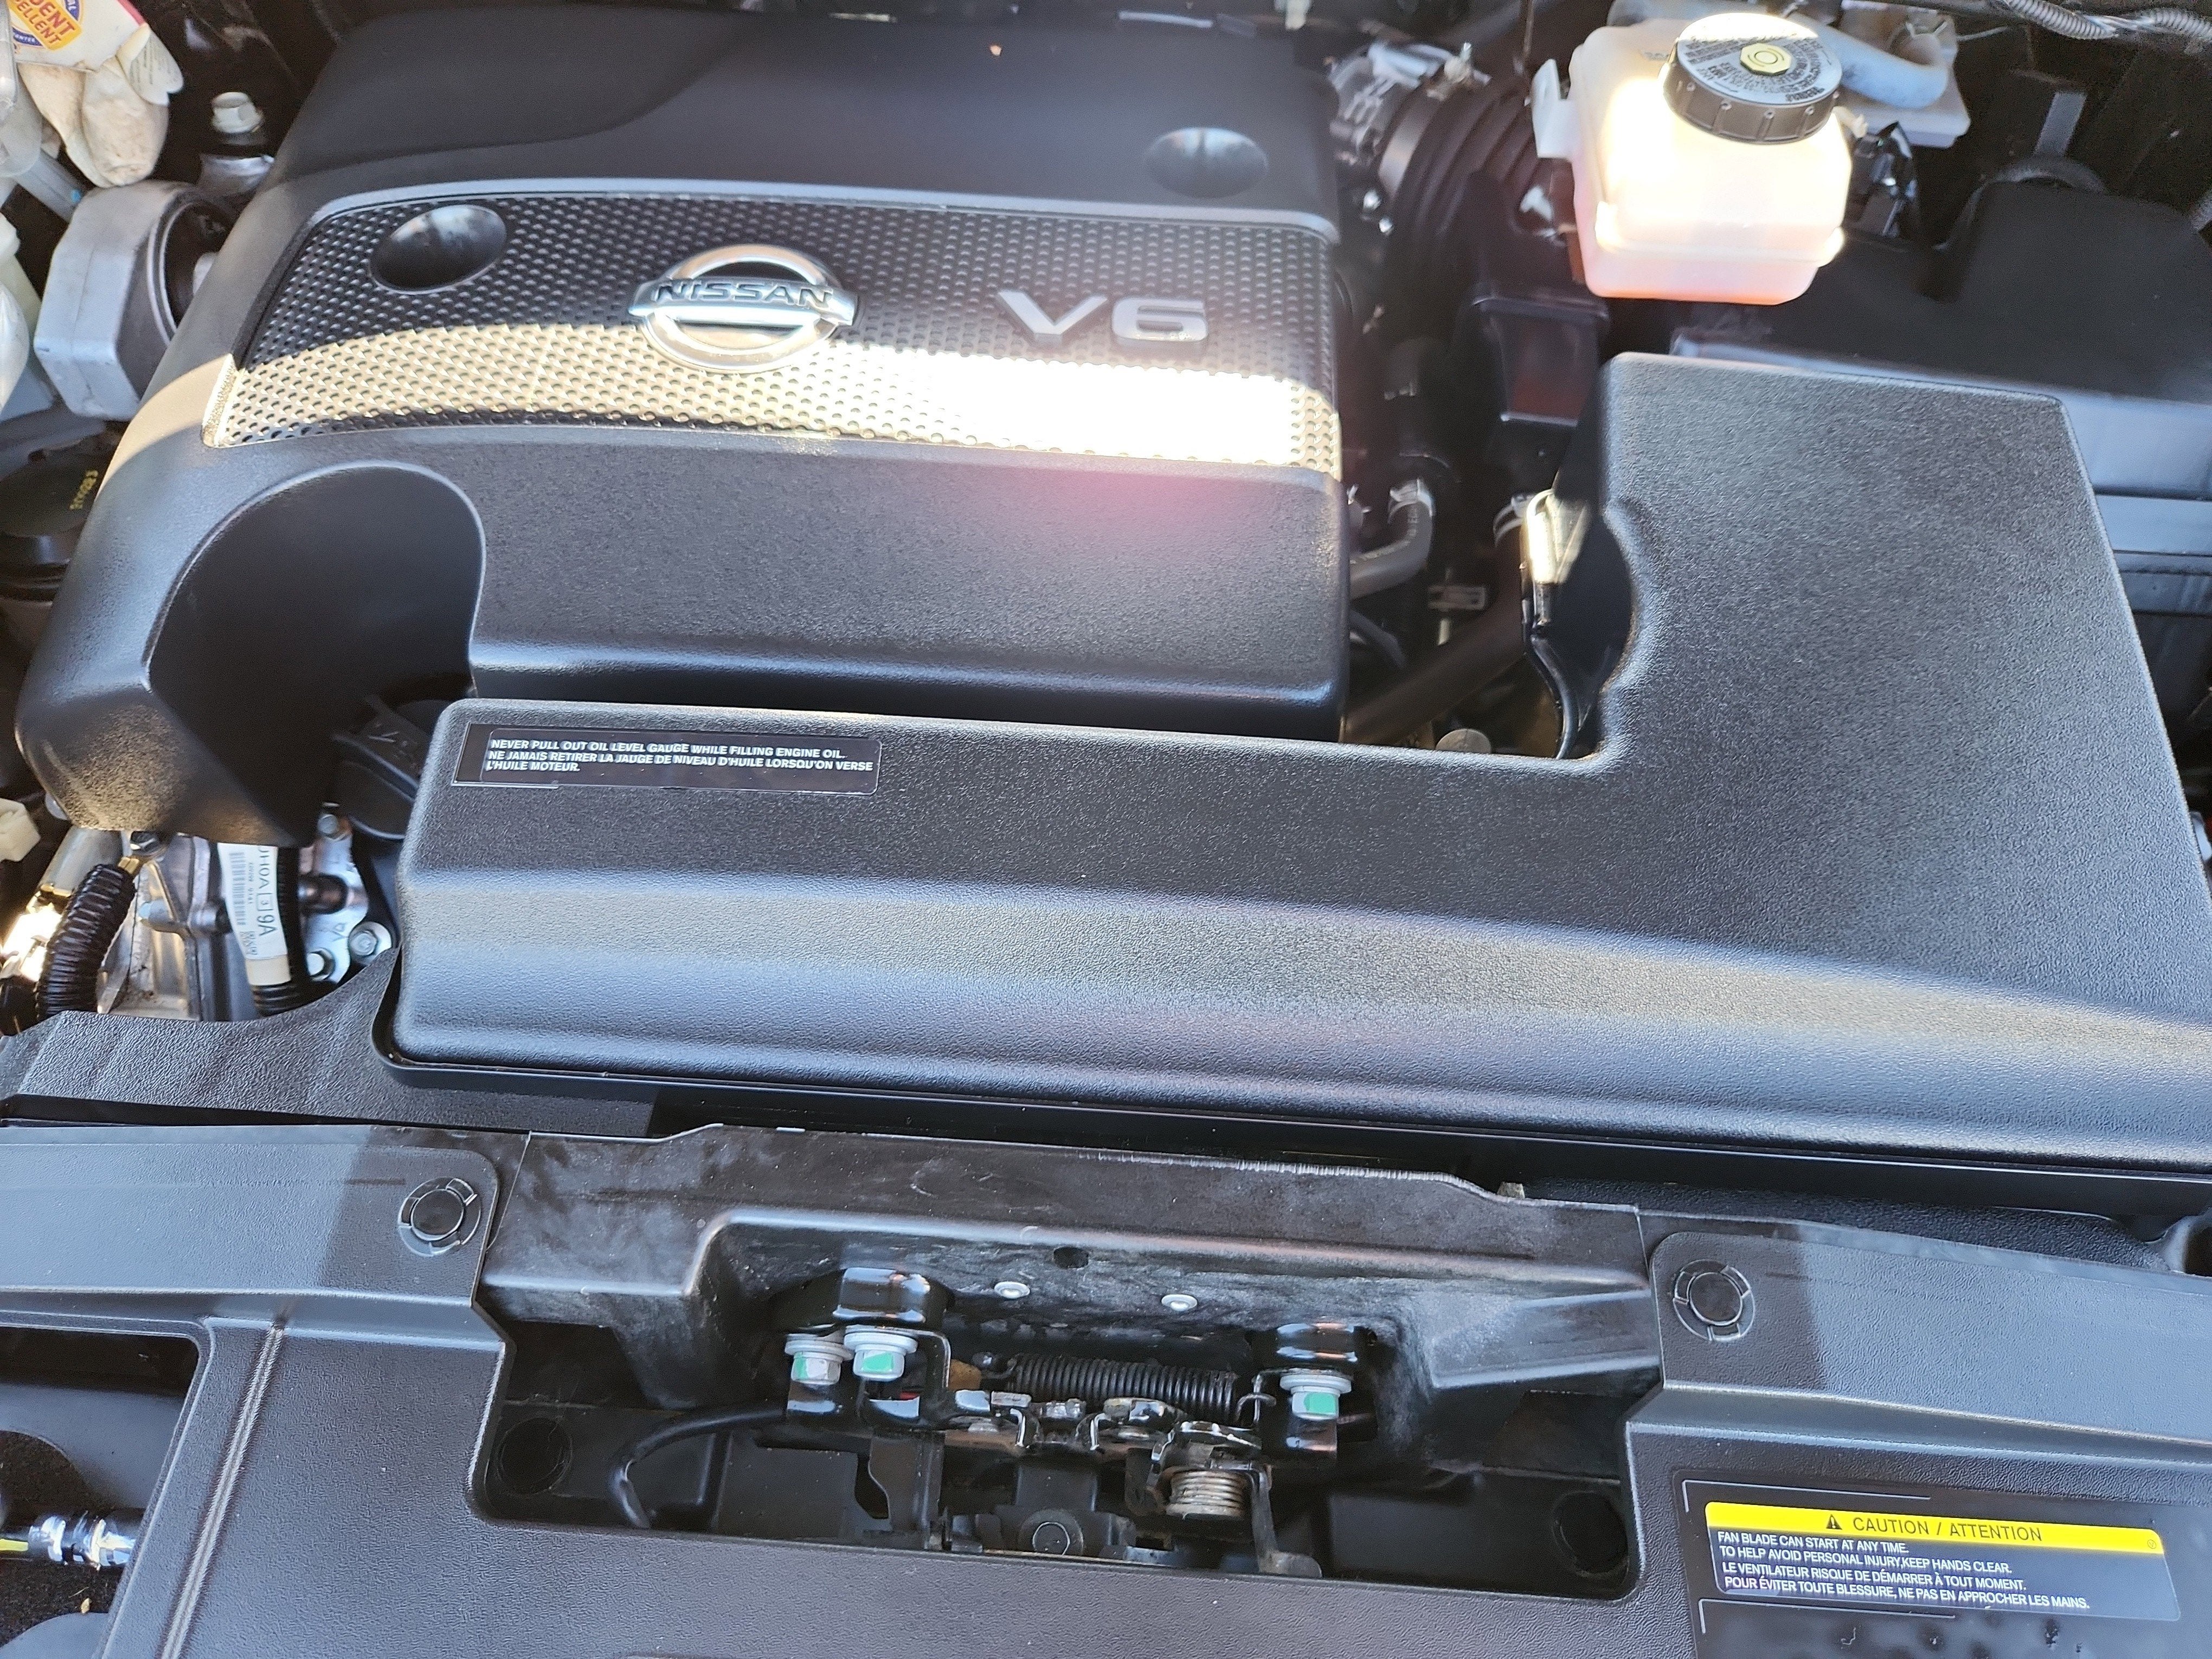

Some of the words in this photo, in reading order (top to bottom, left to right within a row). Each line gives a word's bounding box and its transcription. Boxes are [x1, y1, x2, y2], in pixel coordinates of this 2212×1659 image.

[17, 0, 61, 43] ELLENT
[654, 281, 833, 308] NISSAN
[998, 290, 1208, 342] V6
[489, 751, 504, 760] NE
[507, 751, 547, 761] JAMAIS
[550, 753, 596, 762] RETIRER
[600, 754, 614, 763] LA
[616, 754, 653, 764] JAUGE
[656, 755, 671, 764] DE
[674, 755, 715, 766] NIVEAU
[718, 757, 764, 767] D'HUILE
[766, 758, 833, 769] LORSQU'ON
[835, 761, 873, 771] VERSE
[491, 740, 528, 749] NEVER
[532, 741, 559, 750] PULL
[562, 742, 588, 750] OUT
[589, 742, 609, 751] OIL
[612, 743, 646, 752] LEVEL
[648, 744, 689, 753] GAUGE
[690, 745, 728, 754] WHILE
[730, 746, 773, 756] FILLING
[776, 748, 821, 757] ENGINE
[486, 761, 528, 770] L'HUILE
[530, 762, 580, 771] MOTEUR.
[1718, 1531, 1739, 1543] FAN
[1741, 1533, 1778, 1545] BLADE
[1779, 1535, 1803, 1547] CAN
[1805, 1537, 1838, 1549] START
[1842, 1540, 1854, 1550] AT
[1857, 1540, 1879, 1552] ANY
[1880, 1541, 1909, 1553] TIME.
[1853, 1517, 1929, 1534] CAUTION
[1936, 1522, 1941, 1535] /
[1950, 1523, 2042, 1541] ATTENTION
[1719, 1545, 1735, 1557] TO
[1738, 1547, 1766, 1559] HELP
[1769, 1549, 1802, 1561] AVOID
[1804, 1551, 1863, 1565] PERSONAL
[1932, 1559, 1971, 1571] HANDS
[1973, 1561, 2012, 1573] CLEAR.
[1722, 1562, 1737, 1573] LE
[1738, 1562, 1810, 1578] VENTILATEUR
[1811, 1567, 1853, 1580] RISQUE
[1855, 1570, 1870, 1581] DE
[1872, 1568, 1933, 1585] DÉMARRER
[1935, 1571, 1944, 1585] À
[1945, 1575, 1973, 1587] TOUT
[1975, 1578, 2027, 1590] MOMENT.
[1725, 1576, 1758, 1589] POUR
[1760, 1576, 1796, 1591] ÉVITER
[1797, 1581, 1835, 1594] TOUTE
[1836, 1584, 1896, 1599] BLESSURE,
[1899, 1587, 1914, 1599] NE
[1916, 1588, 1938, 1600] PAS
[1940, 1590, 1956, 1601] EN
[1958, 1590, 2027, 1605] APPROCHER
[2029, 1595, 2050, 1606] LES
[2051, 1596, 2089, 1609] MAINS.
